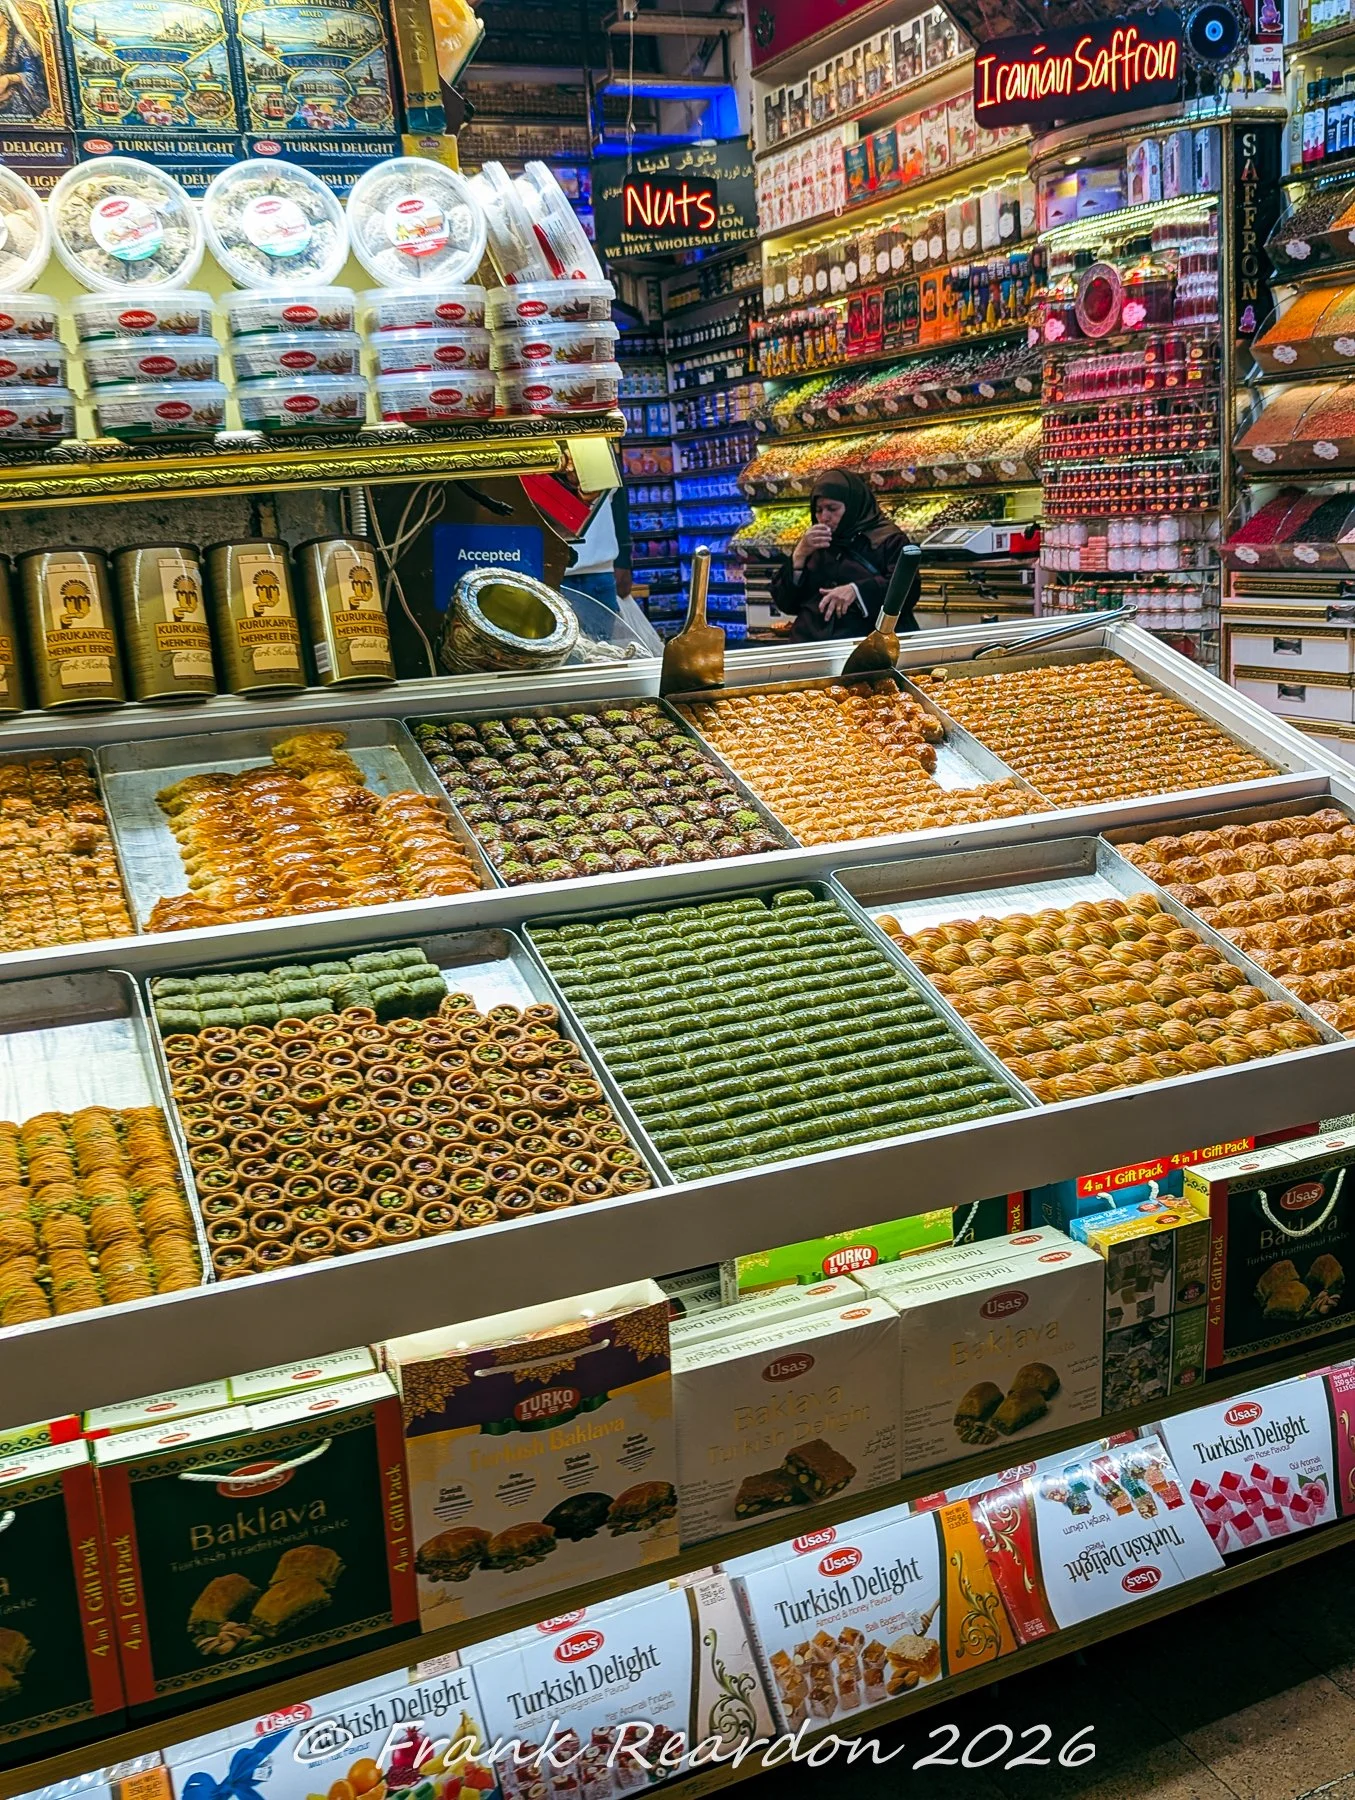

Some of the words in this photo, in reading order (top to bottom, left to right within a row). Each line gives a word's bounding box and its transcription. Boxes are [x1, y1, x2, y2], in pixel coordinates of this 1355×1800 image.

[977, 46, 1074, 109] Iranian
[1075, 27, 1178, 93] Saffron
[3, 141, 65, 153] DELIGHT
[115, 140, 175, 152] TURKISH
[178, 142, 235, 154] DELIGHT
[283, 141, 340, 154] TURKISH
[340, 142, 395, 154] DELIGHT
[637, 154, 671, 174] لدينا
[676, 151, 717, 170] يتوفر
[626, 182, 717, 230] Nuts
[1241, 133, 1259, 301] SAFFRON
[604, 247, 622, 259] WE
[624, 243, 652, 256] HAVE
[655, 233, 721, 251] WHOLESALE
[457, 548, 521, 563] Accepted
[241, 632, 278, 643] MEHMET
[337, 626, 373, 636] MEHMET
[49, 644, 87, 658] MEHMET
[160, 638, 197, 648] MEHMET
[1170, 1153, 1181, 1166] 4
[1182, 1154, 1191, 1164] in
[1192, 1150, 1199, 1161] 1
[1202, 1143, 1224, 1160] Gift
[1224, 1138, 1250, 1154] Pack
[1083, 1181, 1094, 1193] 4
[1094, 1181, 1104, 1191] in
[1105, 1175, 1113, 1188] 1
[1114, 1170, 1138, 1186] Gift
[1138, 1163, 1164, 1181] Pack
[828, 1247, 872, 1266] TURKO
[935, 1249, 987, 1267] Turkish
[1211, 1234, 1225, 1264] Pack
[829, 1259, 871, 1275] BABA
[885, 1260, 935, 1277] Baklava
[964, 1266, 1015, 1284] Turkish
[1210, 1265, 1224, 1292] Gift
[708, 1308, 748, 1327] Turkish
[1210, 1316, 1221, 1326] 4
[952, 1322, 1059, 1367] Baklava
[520, 1387, 575, 1414] TURKO
[733, 1386, 843, 1432] Baklava
[521, 1402, 573, 1421] BABA
[468, 1437, 545, 1474] Turkish
[550, 1416, 625, 1452] Baklava
[1193, 1429, 1254, 1464] Turkish
[1252, 1415, 1310, 1445] Delight
[1243, 1453, 1255, 1463] with
[1255, 1450, 1271, 1461] Rose
[1270, 1445, 1291, 1456] Flavour
[1305, 1464, 1324, 1475] Lokum
[386, 1463, 407, 1501] Pack
[189, 1498, 327, 1552] Baklava
[388, 1501, 406, 1532] Gift
[1062, 1521, 1087, 1535] Lokum
[168, 1550, 226, 1574] Turkish
[230, 1531, 310, 1558] Traditional
[1120, 1525, 1185, 1560] Turkish
[77, 1536, 99, 1578] Pack
[111, 1534, 134, 1574] Pack
[1064, 1545, 1127, 1583] Delight
[393, 1560, 409, 1573] 4
[83, 1580, 105, 1612] Gift
[117, 1576, 137, 1607] Gift
[774, 1581, 854, 1629] Turkish
[850, 1557, 924, 1595] Delight
[87, 1617, 107, 1626] 1
[120, 1612, 139, 1620] 1
[815, 1615, 841, 1628] Almond
[869, 1596, 894, 1609] Flavour
[91, 1645, 110, 1657] 4
[123, 1639, 142, 1650] 4
[507, 1670, 586, 1719] Turkish
[586, 1644, 661, 1690] Delight
[604, 1682, 630, 1699] Flavour
[389, 1677, 470, 1724] Delight
[652, 1700, 676, 1716] Lokum
